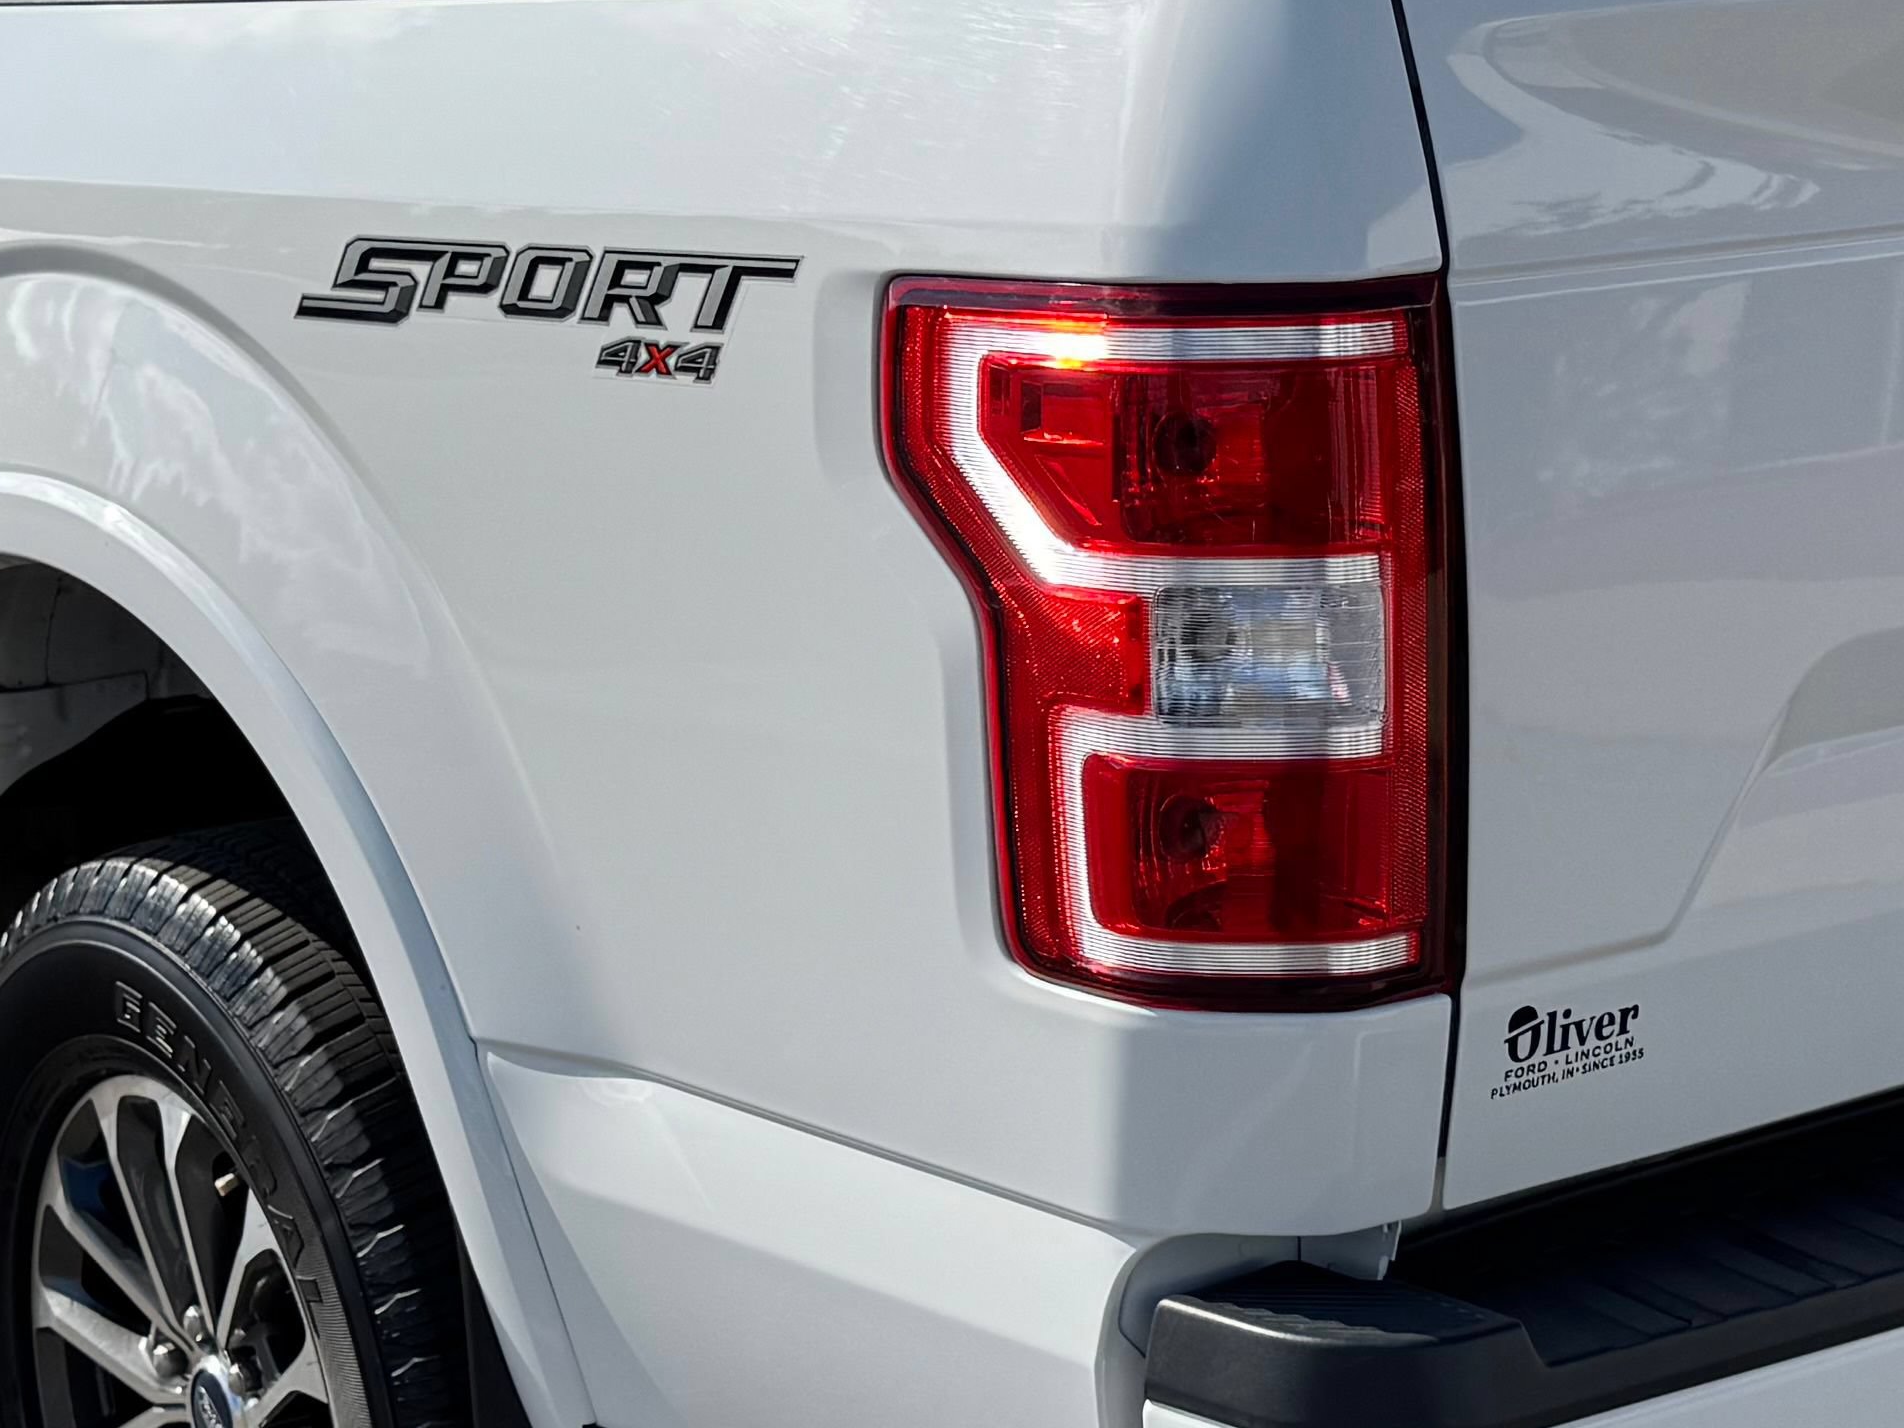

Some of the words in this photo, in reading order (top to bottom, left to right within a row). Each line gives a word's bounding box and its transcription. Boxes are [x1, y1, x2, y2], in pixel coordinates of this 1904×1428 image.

[293, 234, 805, 335] SPORT
[1503, 1004, 1640, 1063] Oliver
[1504, 1060, 1548, 1083] FORD
[1565, 1035, 1635, 1066] LINCOLN
[1490, 1070, 1559, 1100] PLYMOUTH,
[1561, 1065, 1575, 1081] IN
[1581, 1054, 1616, 1075] SINCE
